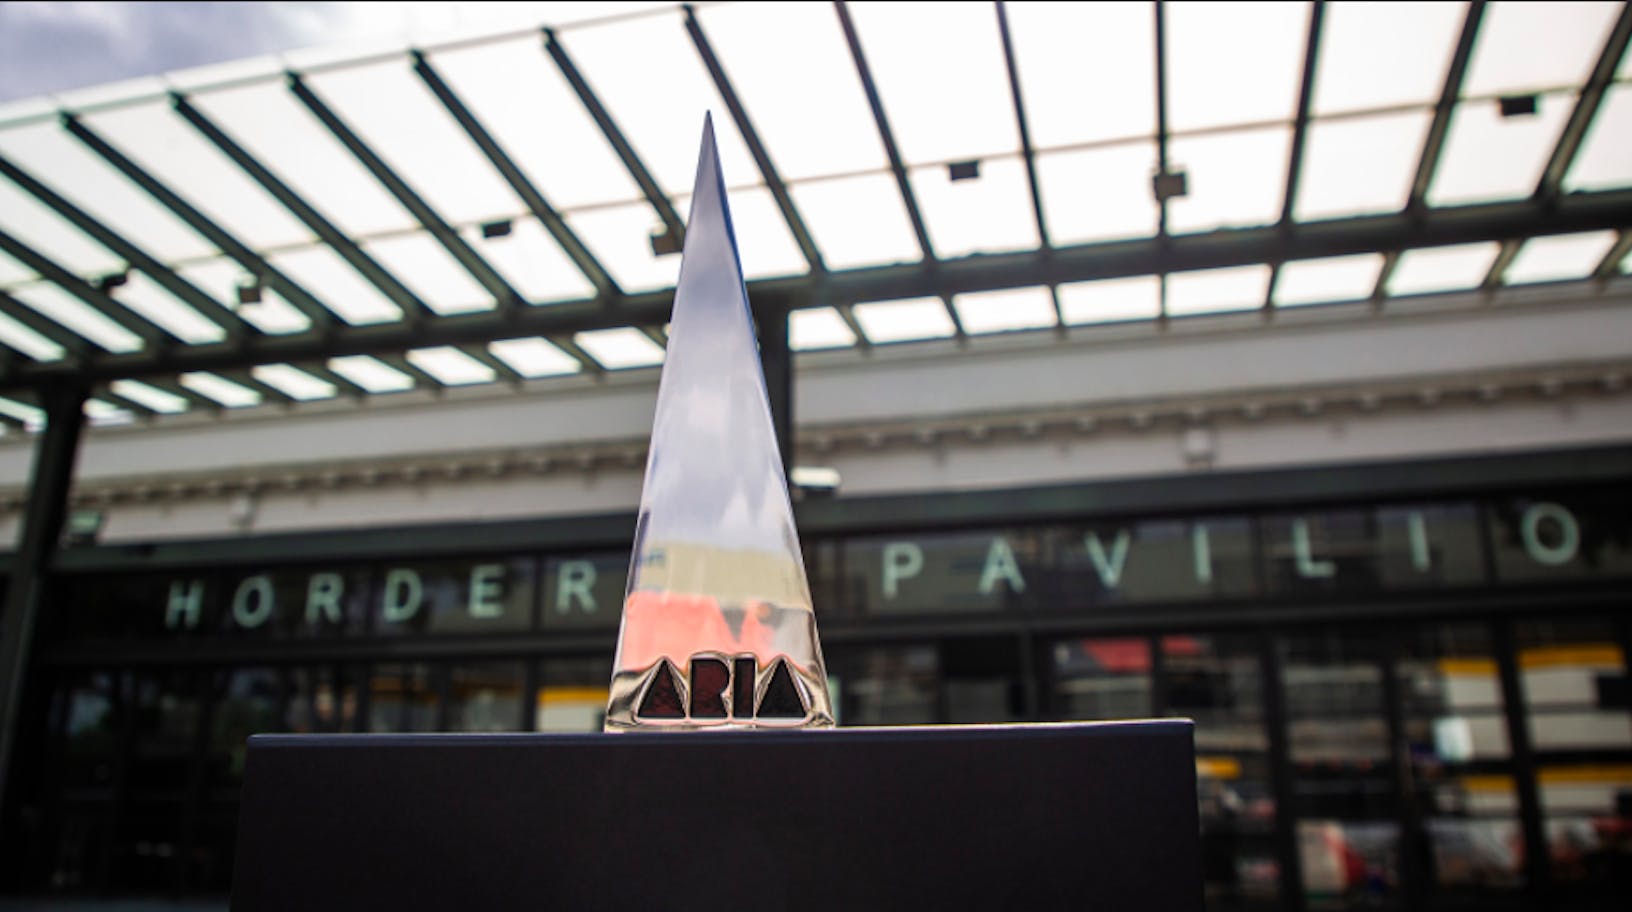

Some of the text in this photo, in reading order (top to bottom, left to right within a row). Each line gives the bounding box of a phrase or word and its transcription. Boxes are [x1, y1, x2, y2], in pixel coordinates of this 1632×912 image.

[166, 503, 1580, 628] HORDER PAVILIO
[634, 655, 810, 721] ARIA
